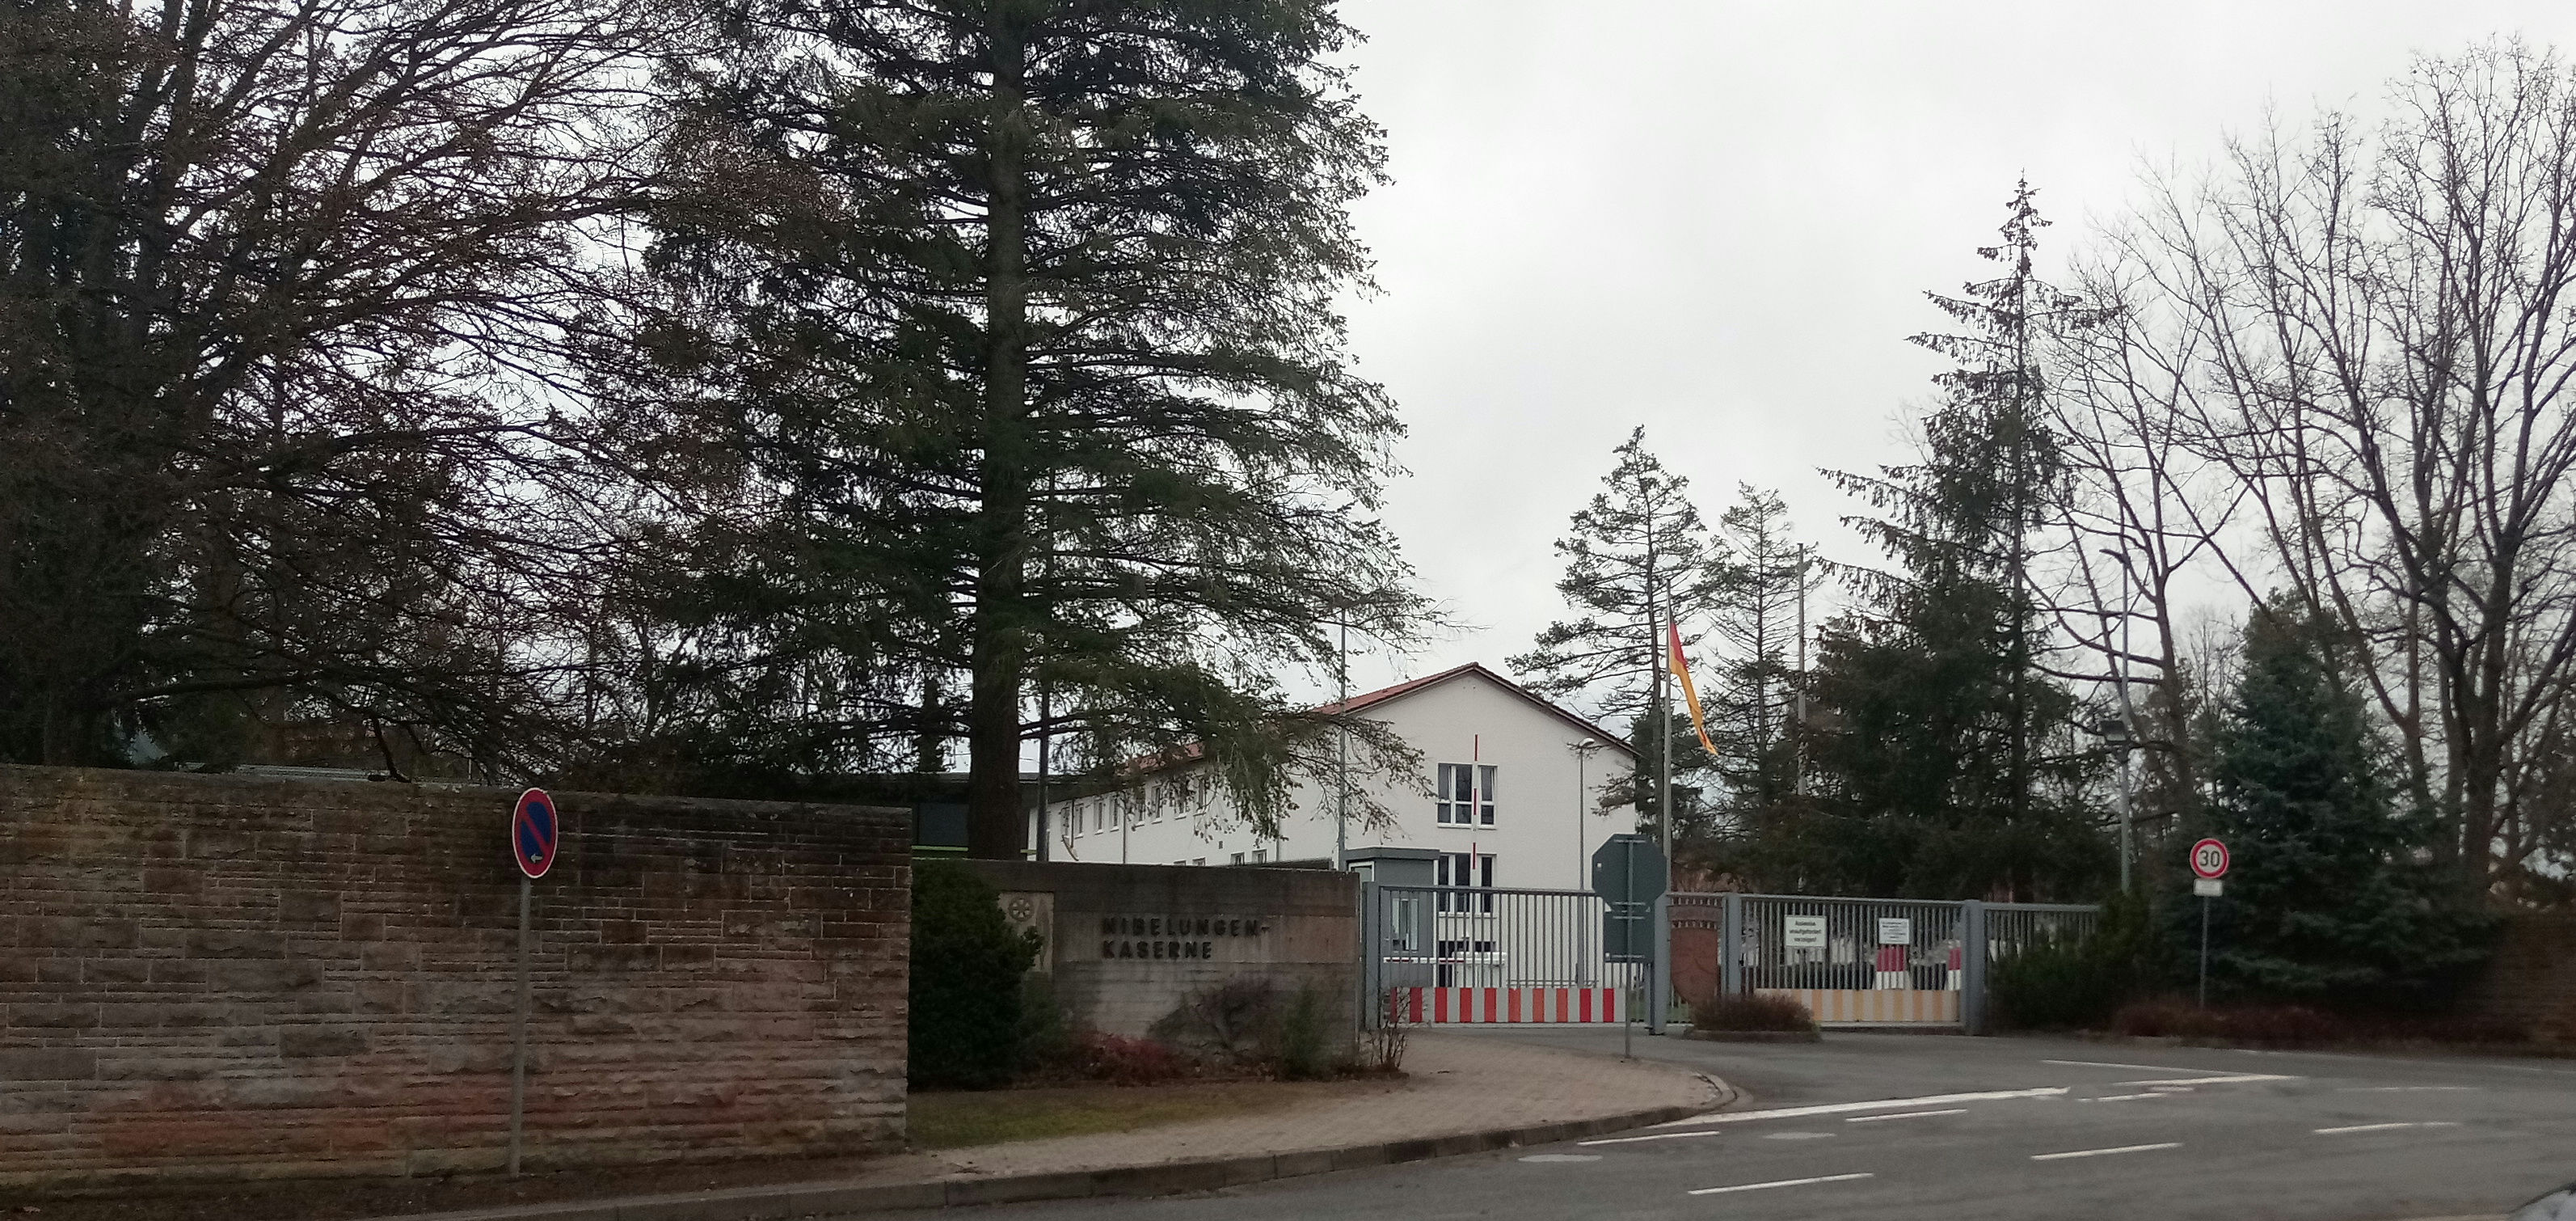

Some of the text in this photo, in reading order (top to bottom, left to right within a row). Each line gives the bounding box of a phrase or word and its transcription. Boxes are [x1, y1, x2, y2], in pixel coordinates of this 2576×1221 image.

[2199, 850, 2220, 867] 30
[1102, 918, 1271, 937] NIBELUNGEN-
[1102, 940, 1212, 960] KASERNE
